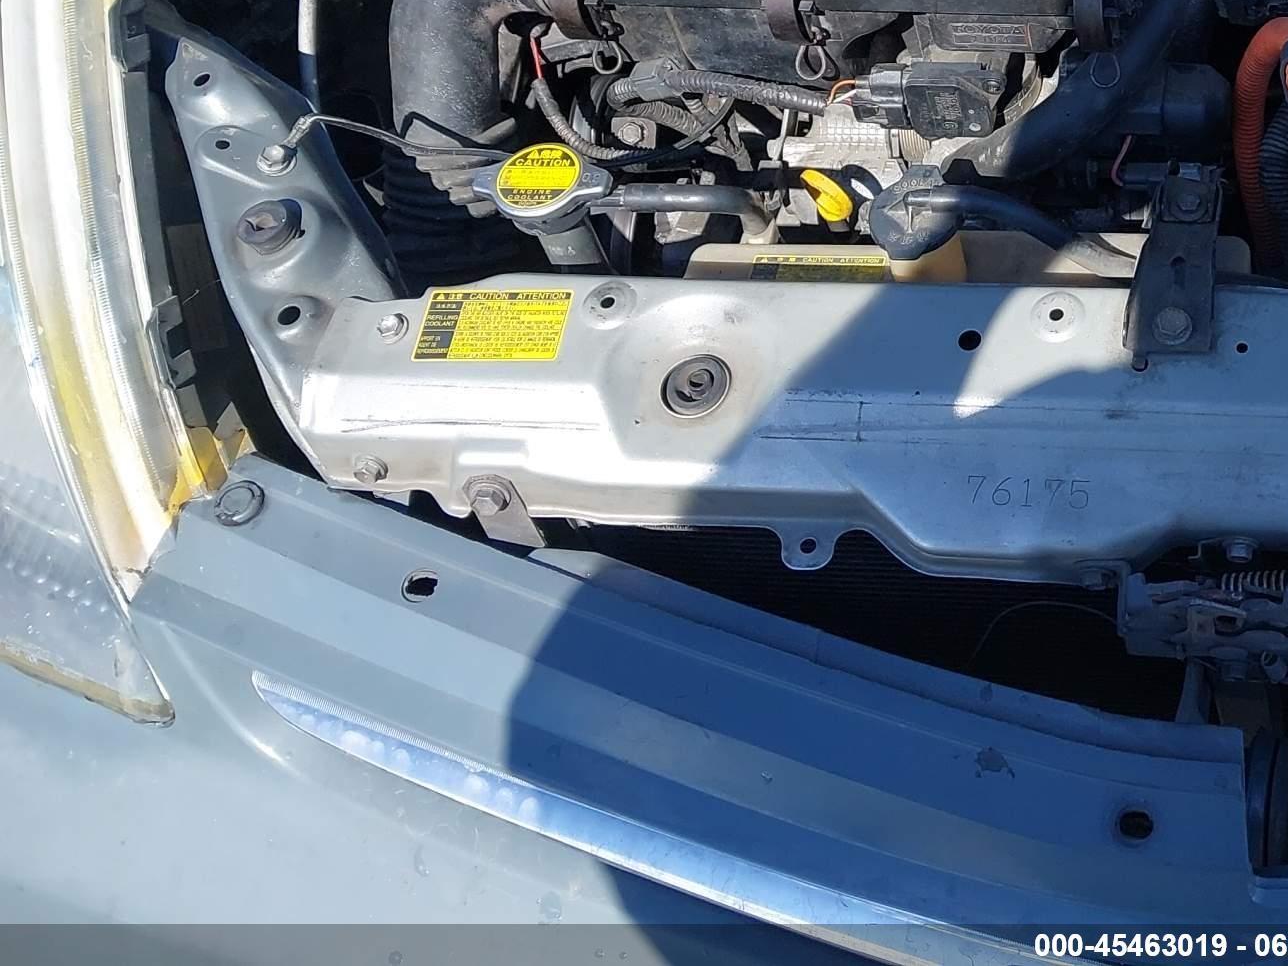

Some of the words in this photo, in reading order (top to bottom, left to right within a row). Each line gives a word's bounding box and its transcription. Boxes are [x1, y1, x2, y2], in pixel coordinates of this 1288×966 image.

[952, 24, 1026, 34] TOYOTA
[515, 158, 571, 167] CAUTION
[469, 292, 510, 300] CAUTION
[516, 292, 567, 300] ATTENTION
[967, 475, 1091, 509] 76175
